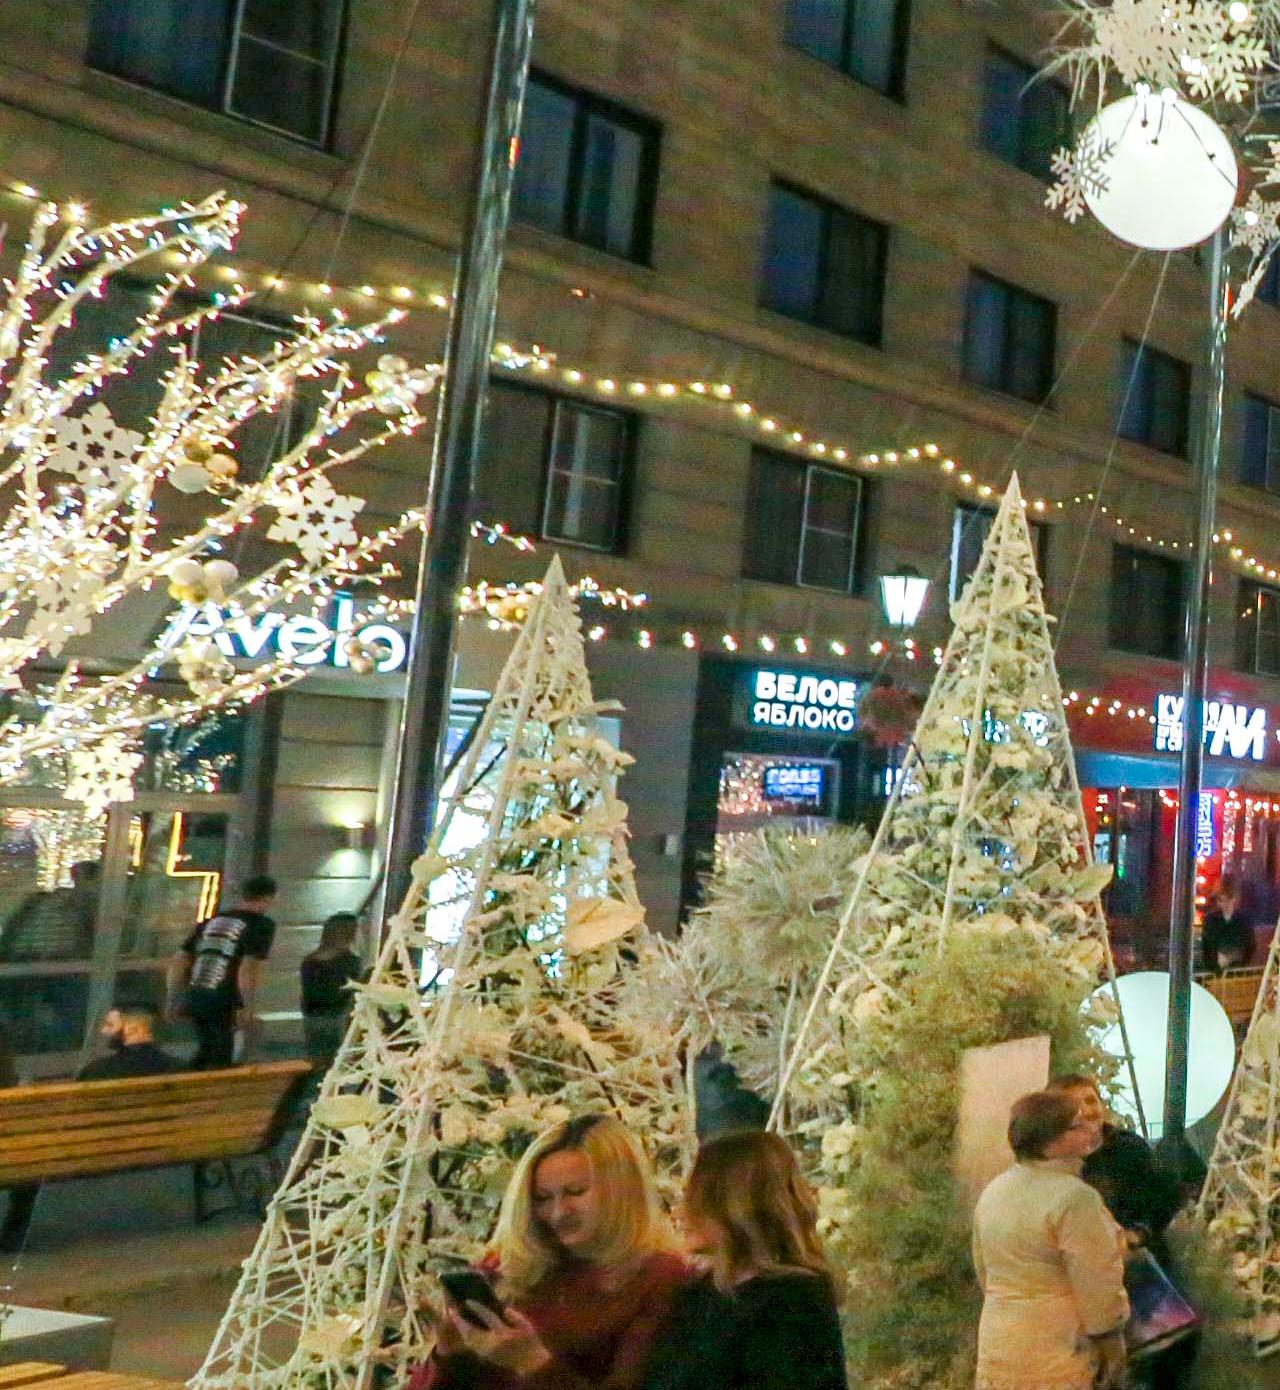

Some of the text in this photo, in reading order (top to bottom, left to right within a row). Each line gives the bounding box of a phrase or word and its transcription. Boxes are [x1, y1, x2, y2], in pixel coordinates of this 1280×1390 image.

[160, 590, 406, 674] Avelo
[756, 671, 856, 708] БЕЛОЕ
[753, 702, 854, 732] ЯБЛОКО
